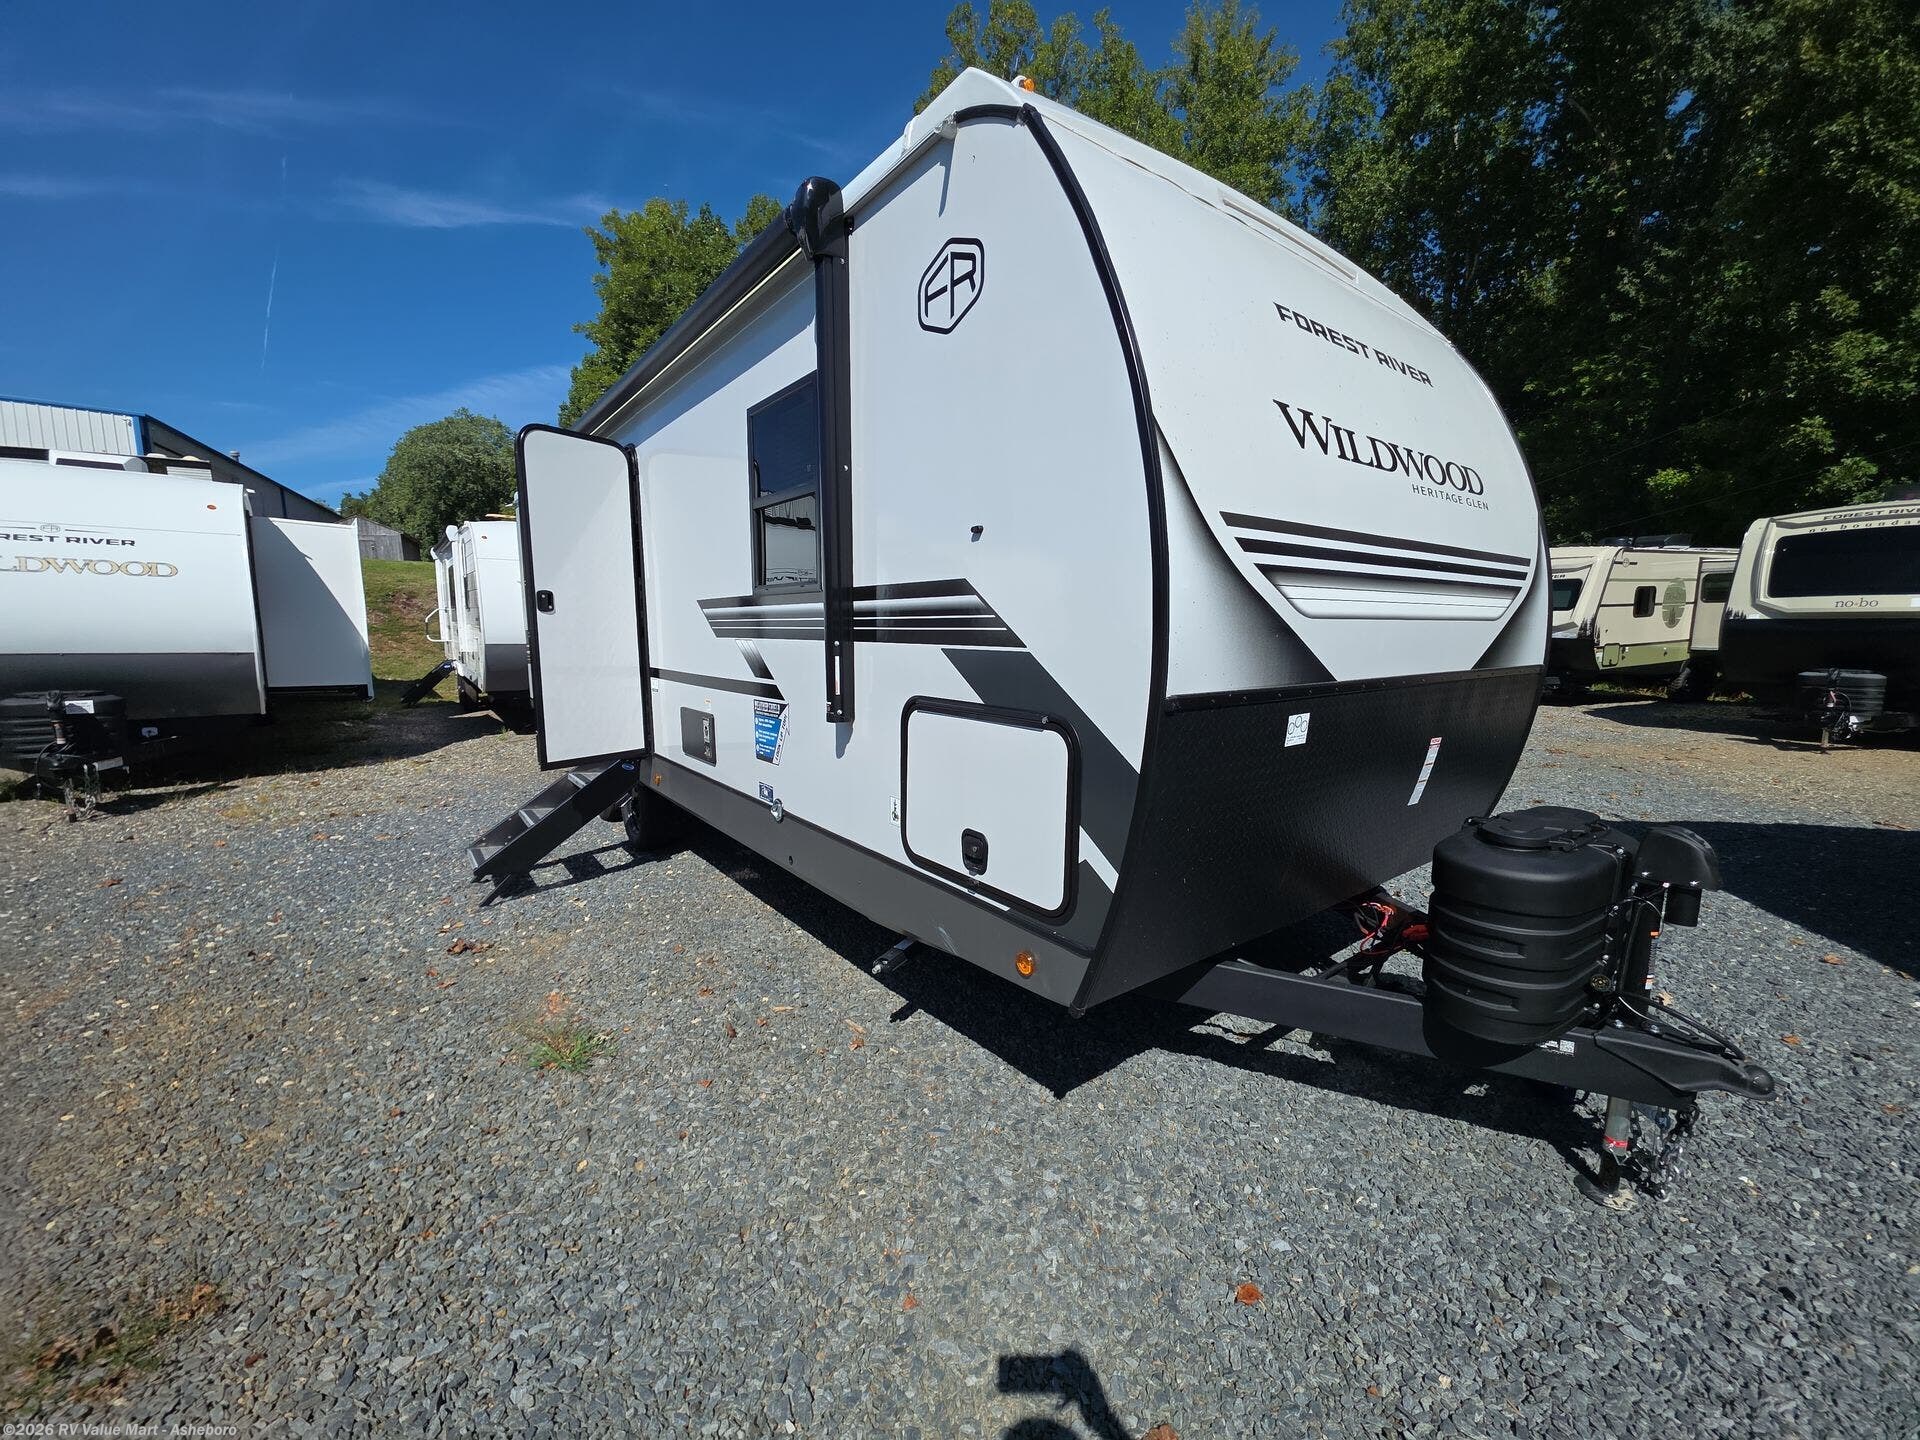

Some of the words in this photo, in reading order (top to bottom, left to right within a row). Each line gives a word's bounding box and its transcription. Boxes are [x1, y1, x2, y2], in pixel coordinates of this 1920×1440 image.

[1273, 301, 1369, 359] FOREST
[1373, 348, 1434, 388] RIVER
[1272, 398, 1484, 496] WILDWOOD
[1411, 483, 1464, 505] HERITAGE
[1465, 497, 1490, 511] GLEN
[1823, 511, 1884, 520] FOREST
[66, 536, 136, 547] RIVER
